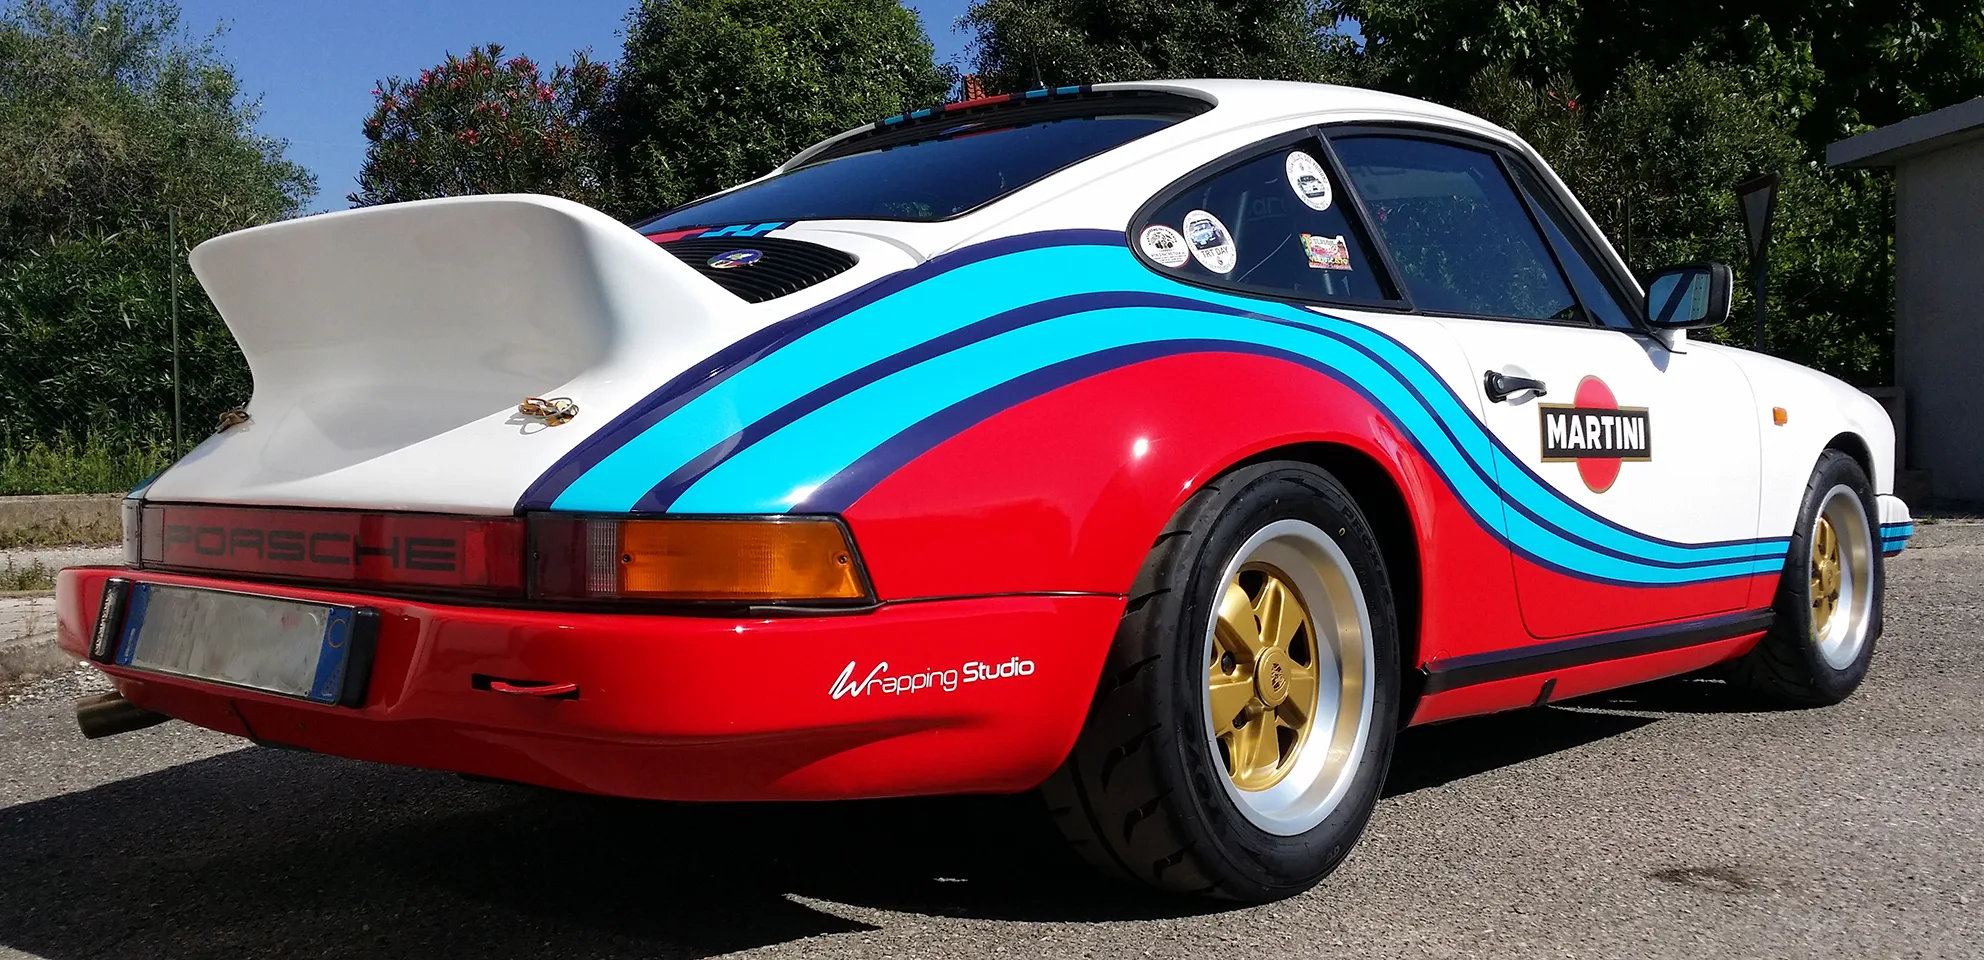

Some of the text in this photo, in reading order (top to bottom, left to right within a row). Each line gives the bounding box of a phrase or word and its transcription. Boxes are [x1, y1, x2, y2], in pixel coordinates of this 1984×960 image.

[1215, 246, 1229, 256] DAY
[1546, 413, 1646, 450] MARTINI
[166, 524, 456, 571] PORSCHE
[828, 656, 1035, 700] Wrapping Studio
